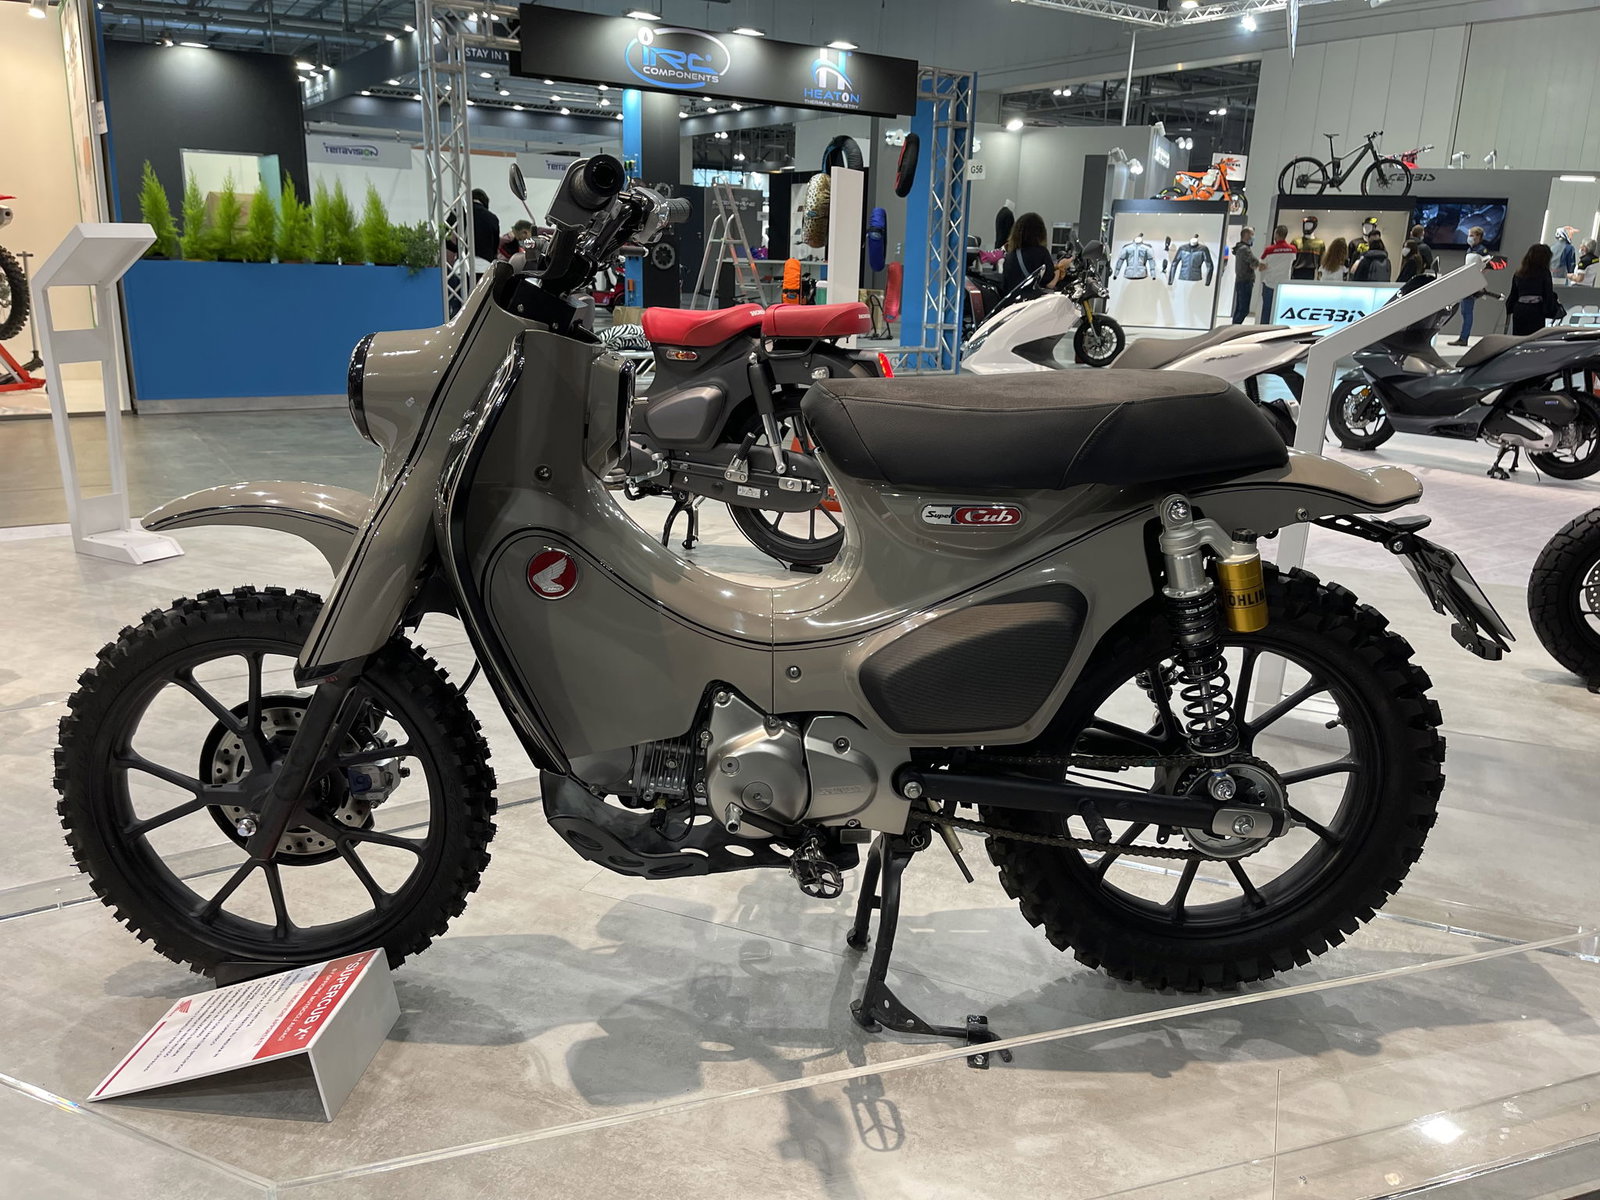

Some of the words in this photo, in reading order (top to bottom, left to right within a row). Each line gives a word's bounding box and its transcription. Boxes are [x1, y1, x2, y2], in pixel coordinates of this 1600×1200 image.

[465, 47, 488, 58] STAY
[491, 50, 502, 60] IN
[642, 65, 720, 84] COMPONENTS
[803, 87, 861, 104] HEATON
[970, 164, 984, 175] G56
[925, 510, 953, 520] Super
[964, 509, 1014, 523] Cub
